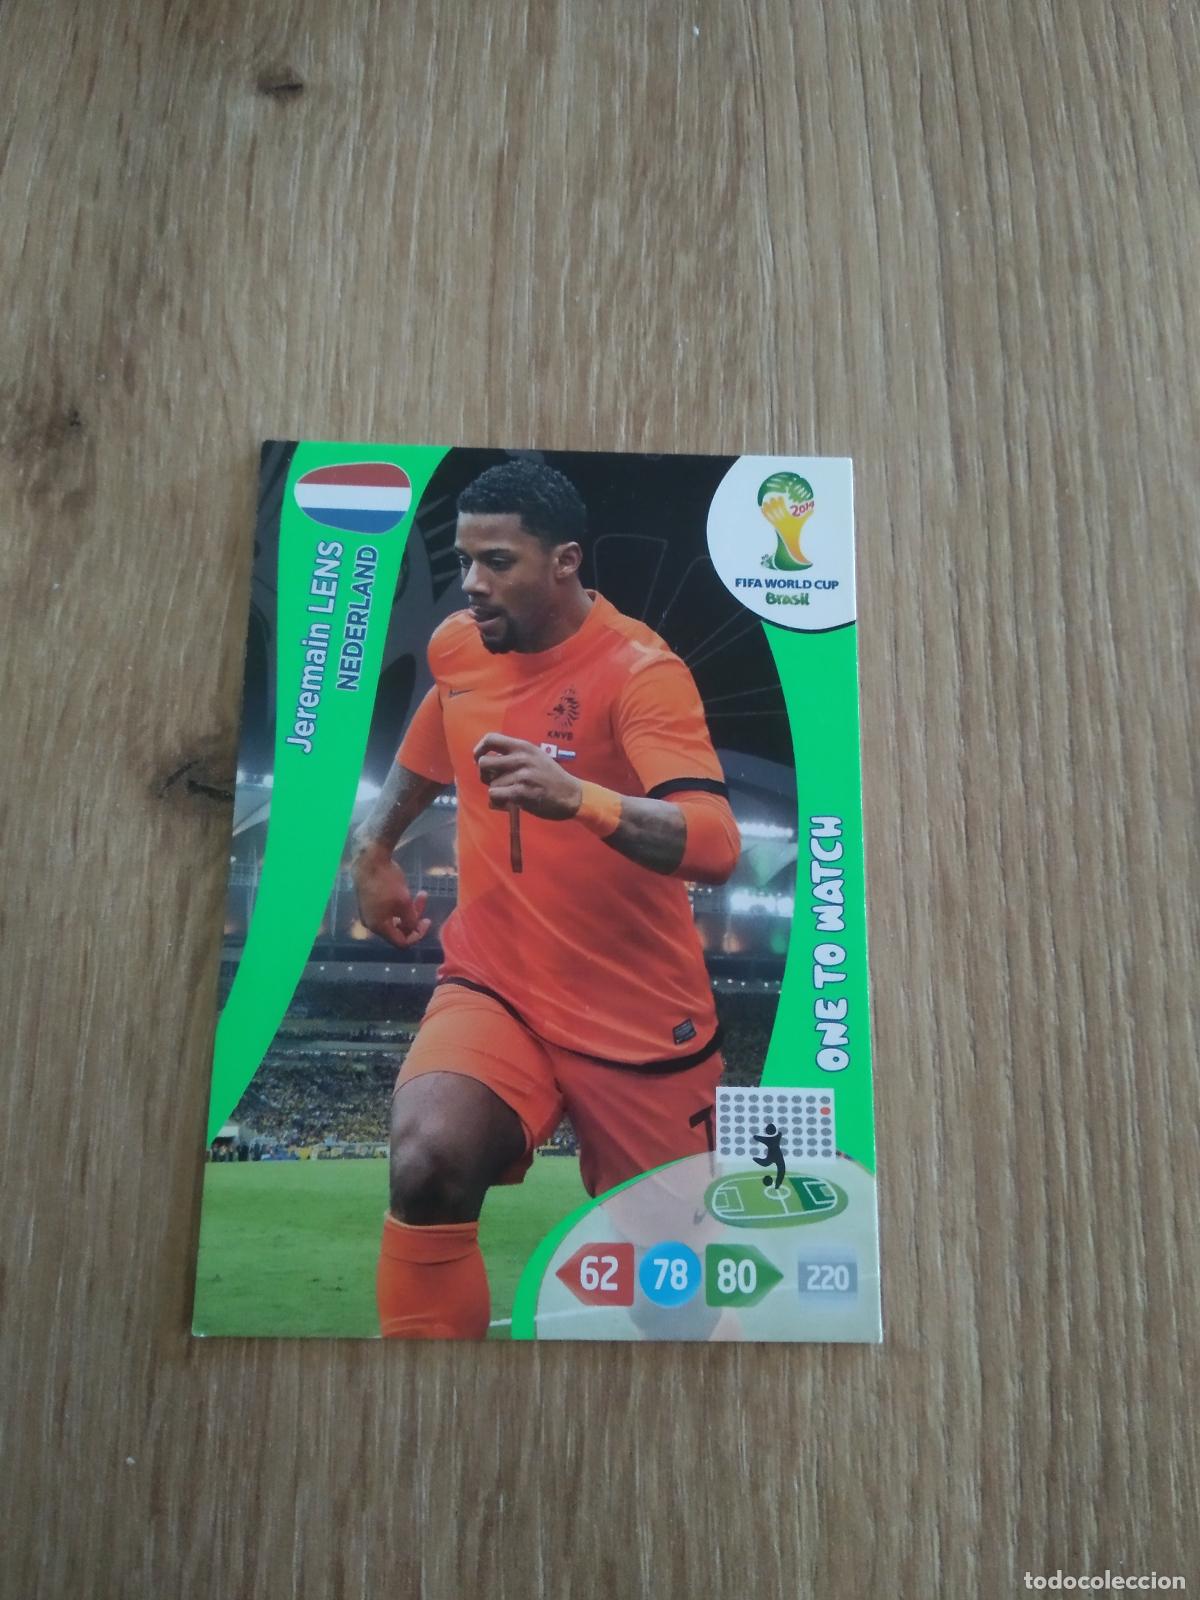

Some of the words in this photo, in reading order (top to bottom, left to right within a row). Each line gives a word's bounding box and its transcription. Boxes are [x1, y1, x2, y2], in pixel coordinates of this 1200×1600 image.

[790, 501, 815, 517] 2014
[308, 540, 344, 615] LENS
[735, 578, 762, 588] FIFA
[765, 579, 812, 589] WORLD
[814, 580, 839, 590] CUP
[766, 592, 810, 605] Brasil
[336, 544, 378, 692] NEDERLAND
[287, 622, 331, 755] Jeremain
[547, 730, 574, 741] KNVB
[810, 815, 845, 932] WATCH
[812, 942, 847, 989] TO
[814, 998, 850, 1072] ONE
[580, 1256, 619, 1291] 62
[653, 1258, 688, 1291] 78
[717, 1258, 757, 1294] 80
[806, 1266, 850, 1291] 220
